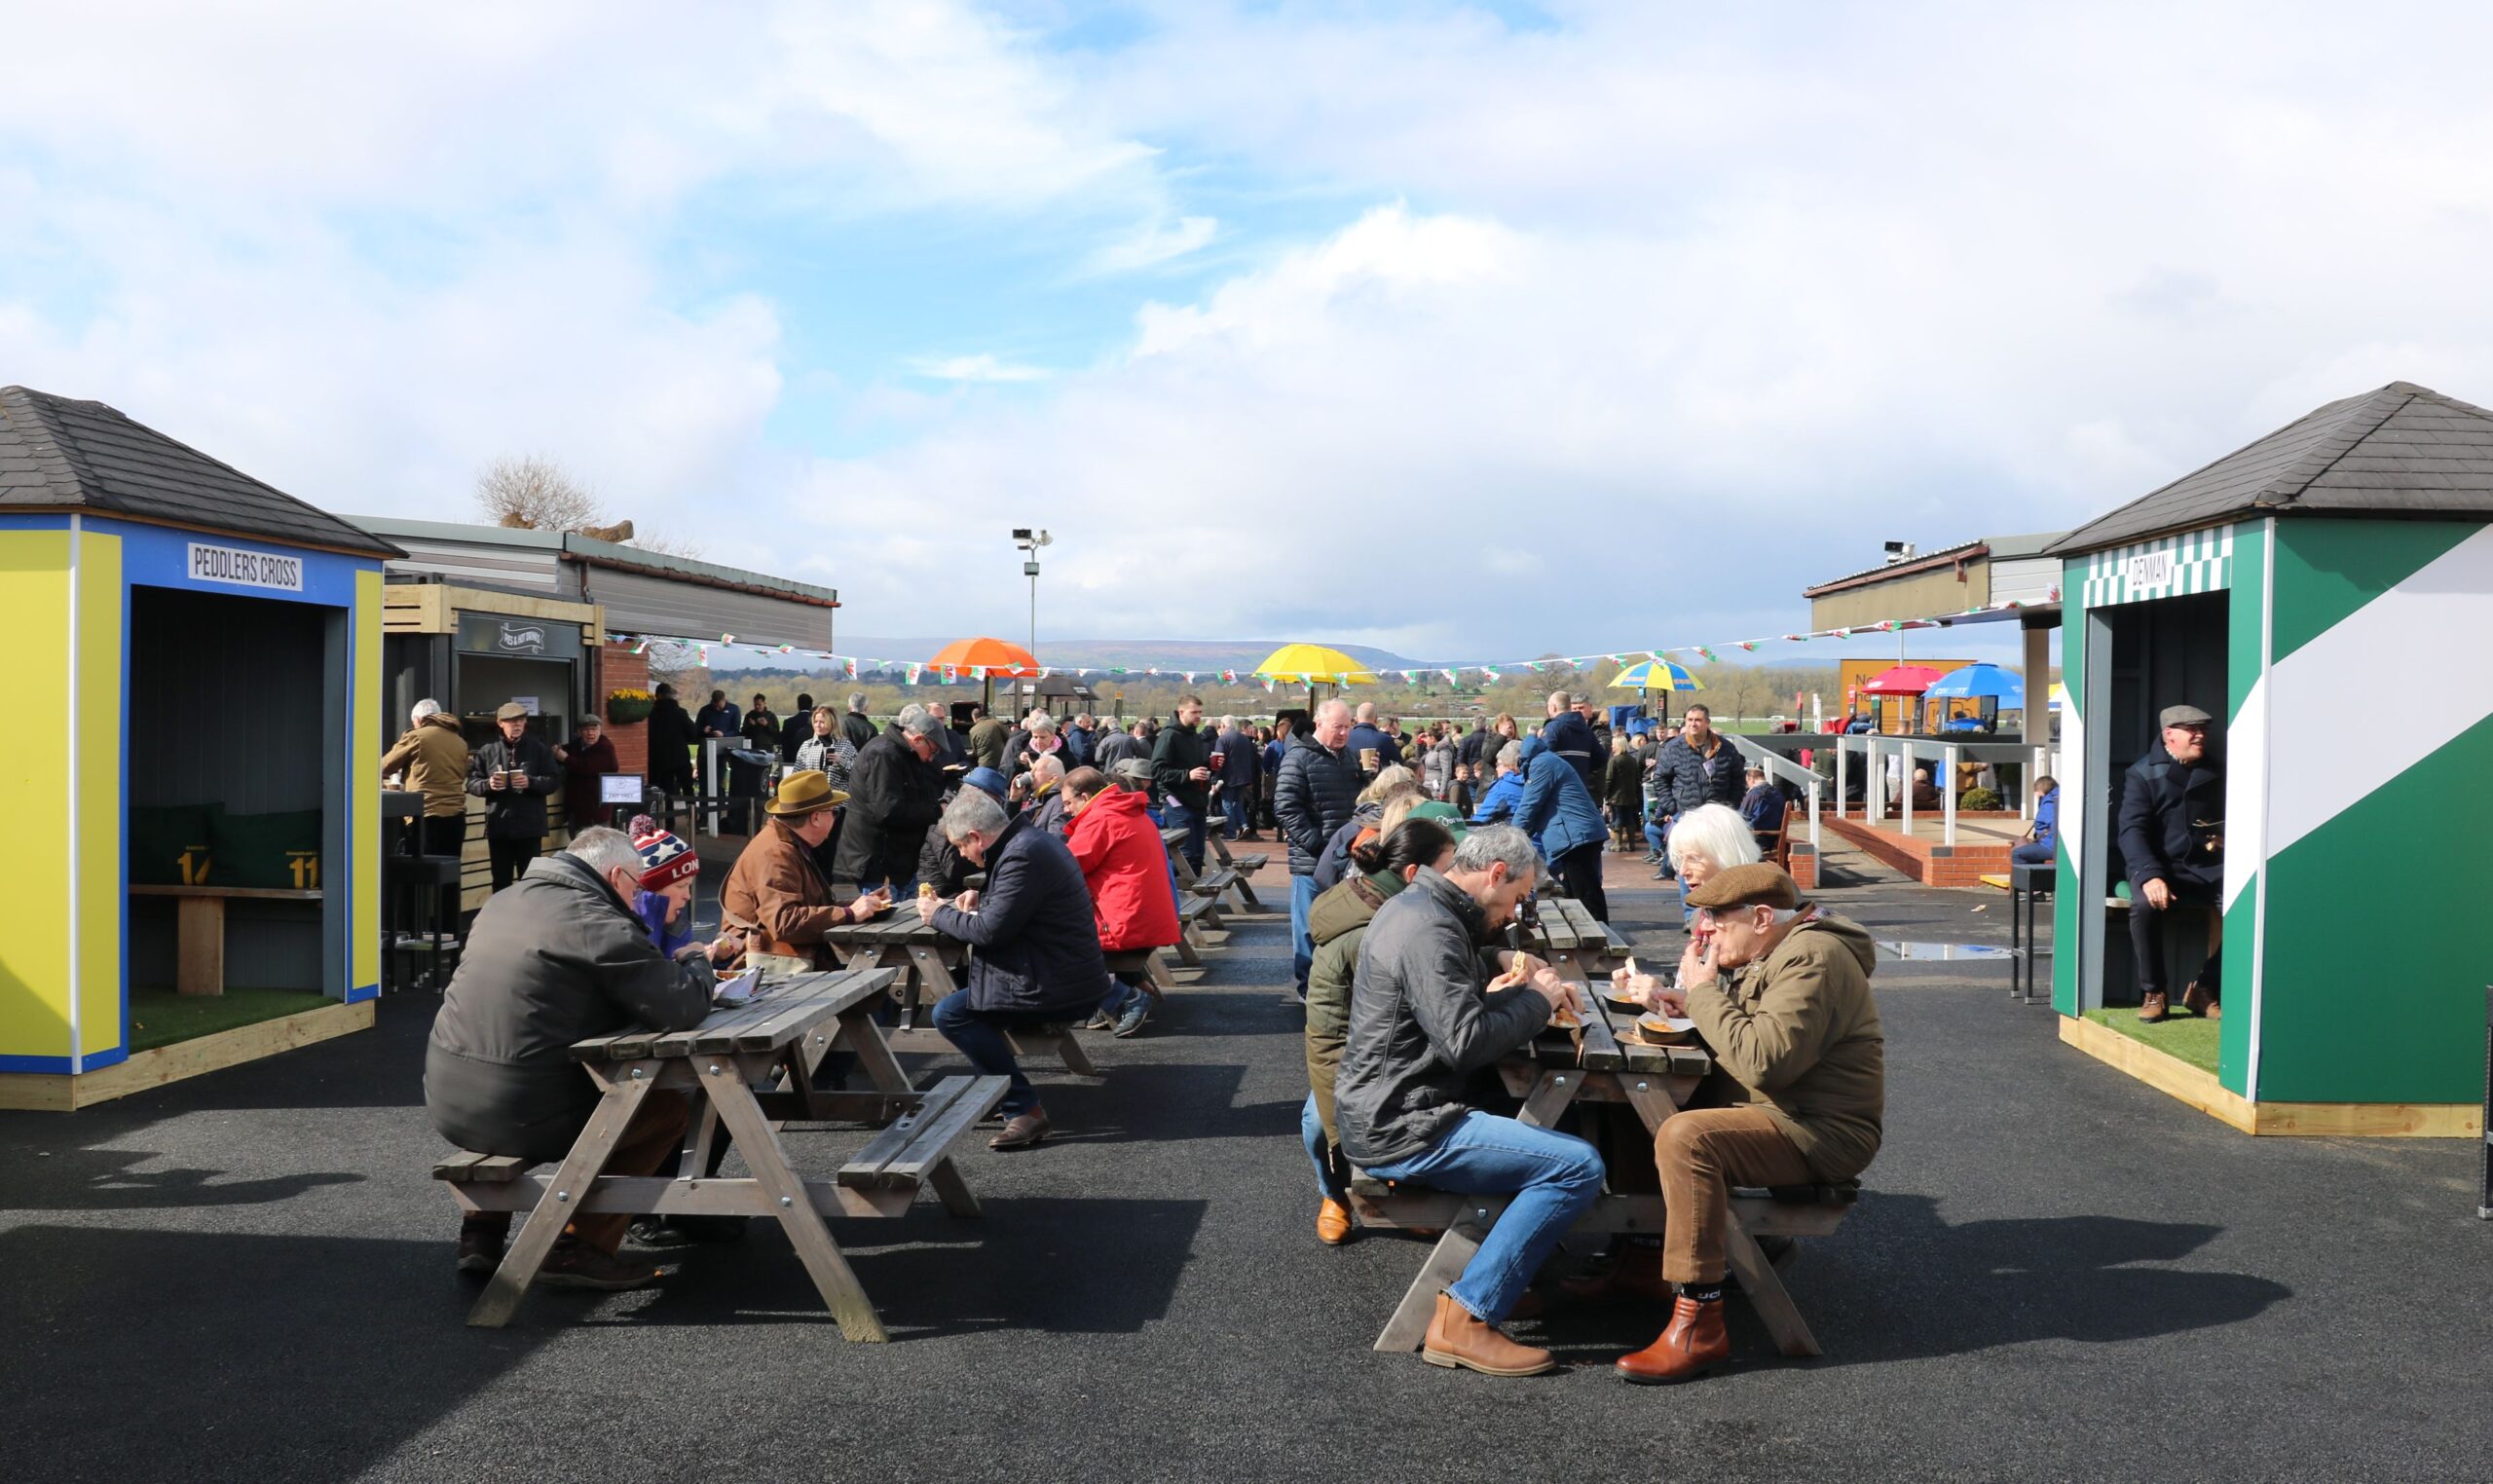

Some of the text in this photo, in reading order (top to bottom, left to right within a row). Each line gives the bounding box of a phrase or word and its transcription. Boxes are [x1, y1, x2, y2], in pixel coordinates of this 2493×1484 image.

[195, 547, 297, 587] PEDDLERS CROSS
[2133, 554, 2167, 586] DENMAN
